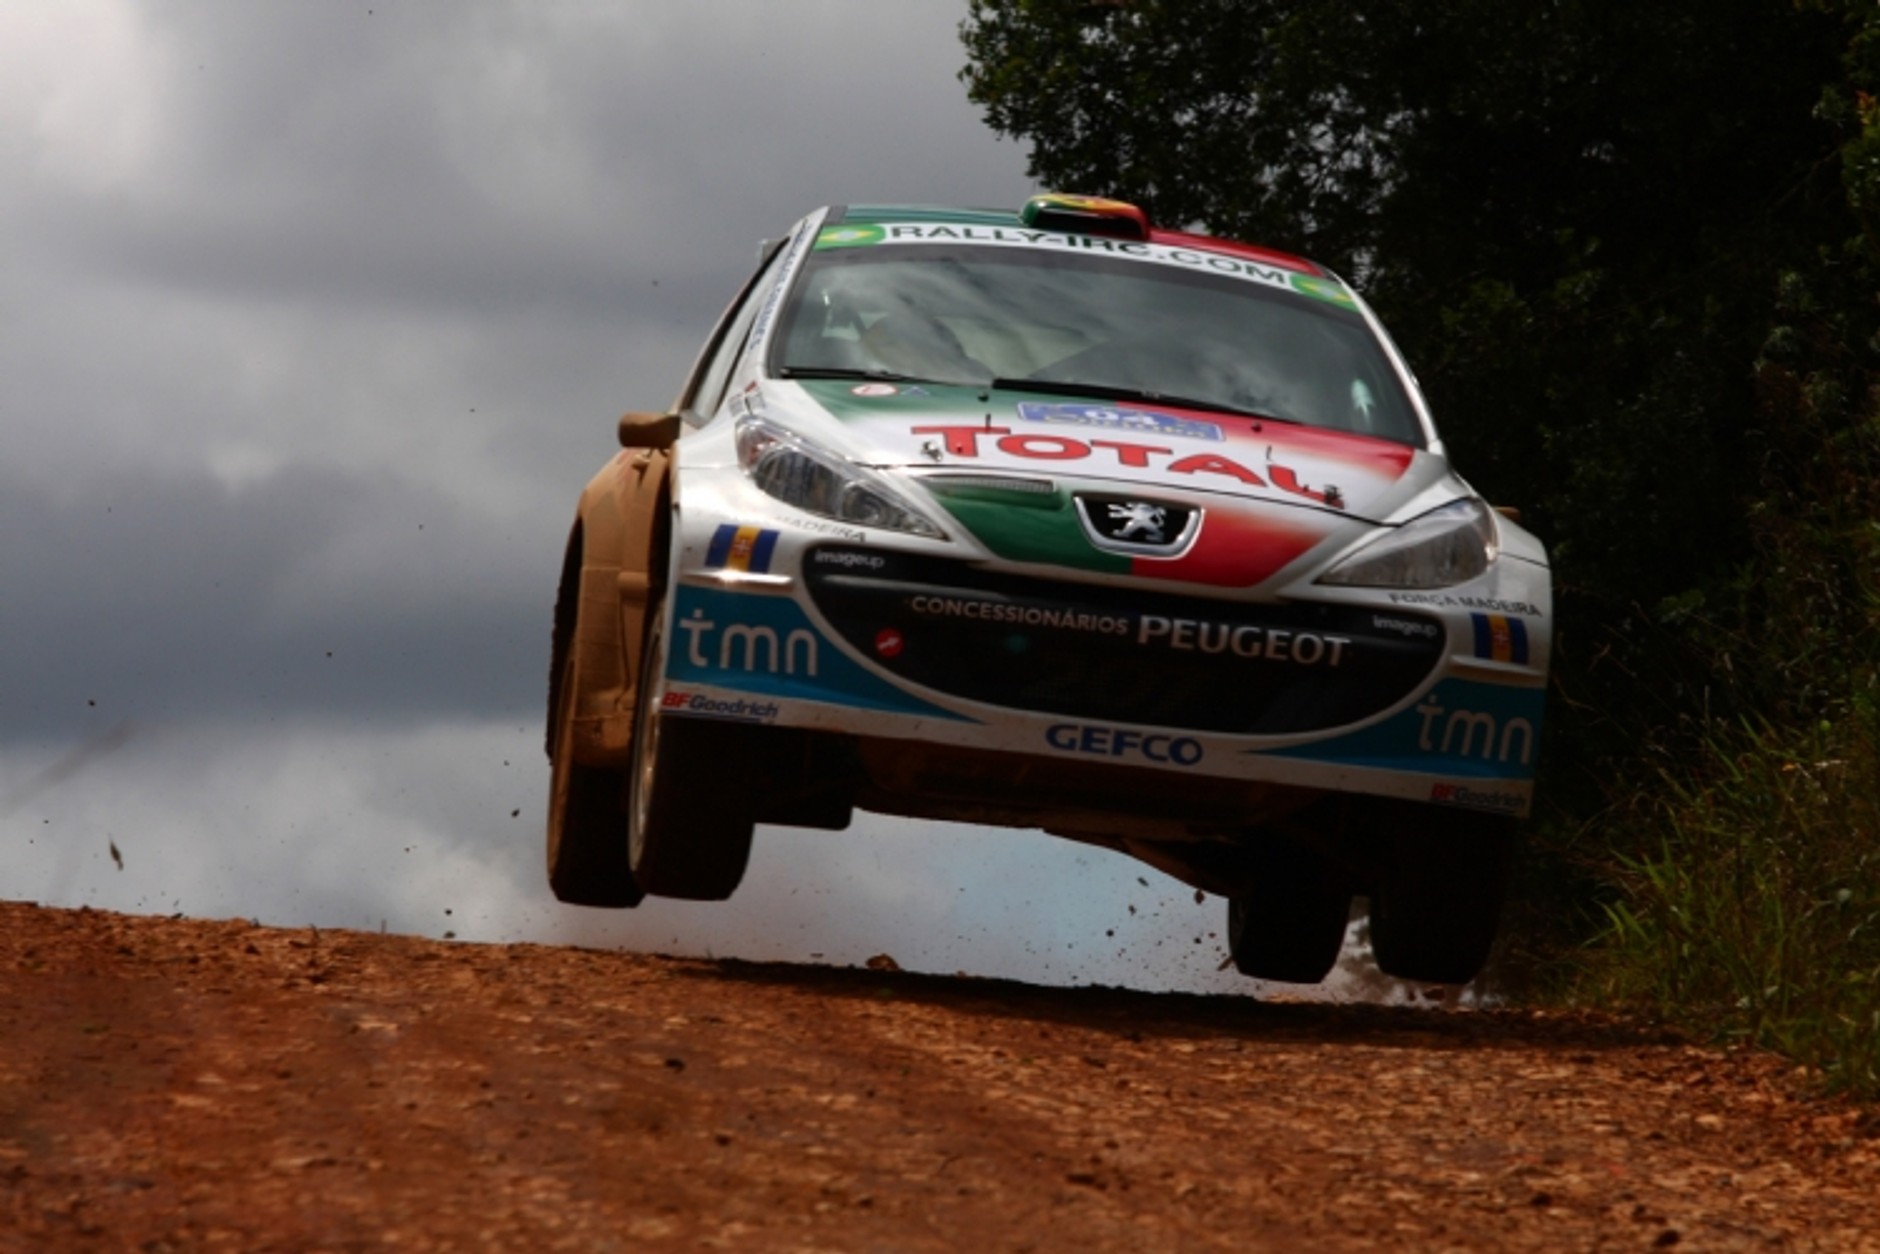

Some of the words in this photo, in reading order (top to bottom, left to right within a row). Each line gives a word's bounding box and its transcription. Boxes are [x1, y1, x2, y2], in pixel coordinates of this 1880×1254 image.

[891, 226, 1286, 285] RALLY-IRC.COM
[910, 425, 1346, 510] TOTAL
[813, 548, 886, 570] imageup
[678, 607, 818, 677] tmn
[911, 594, 1130, 635] CONCESSIONÁRIOS
[1136, 613, 1351, 668] PEUGEOT
[1371, 614, 1439, 638] imageup
[1045, 723, 1204, 766] GEFCO
[1415, 693, 1534, 765] tmn
